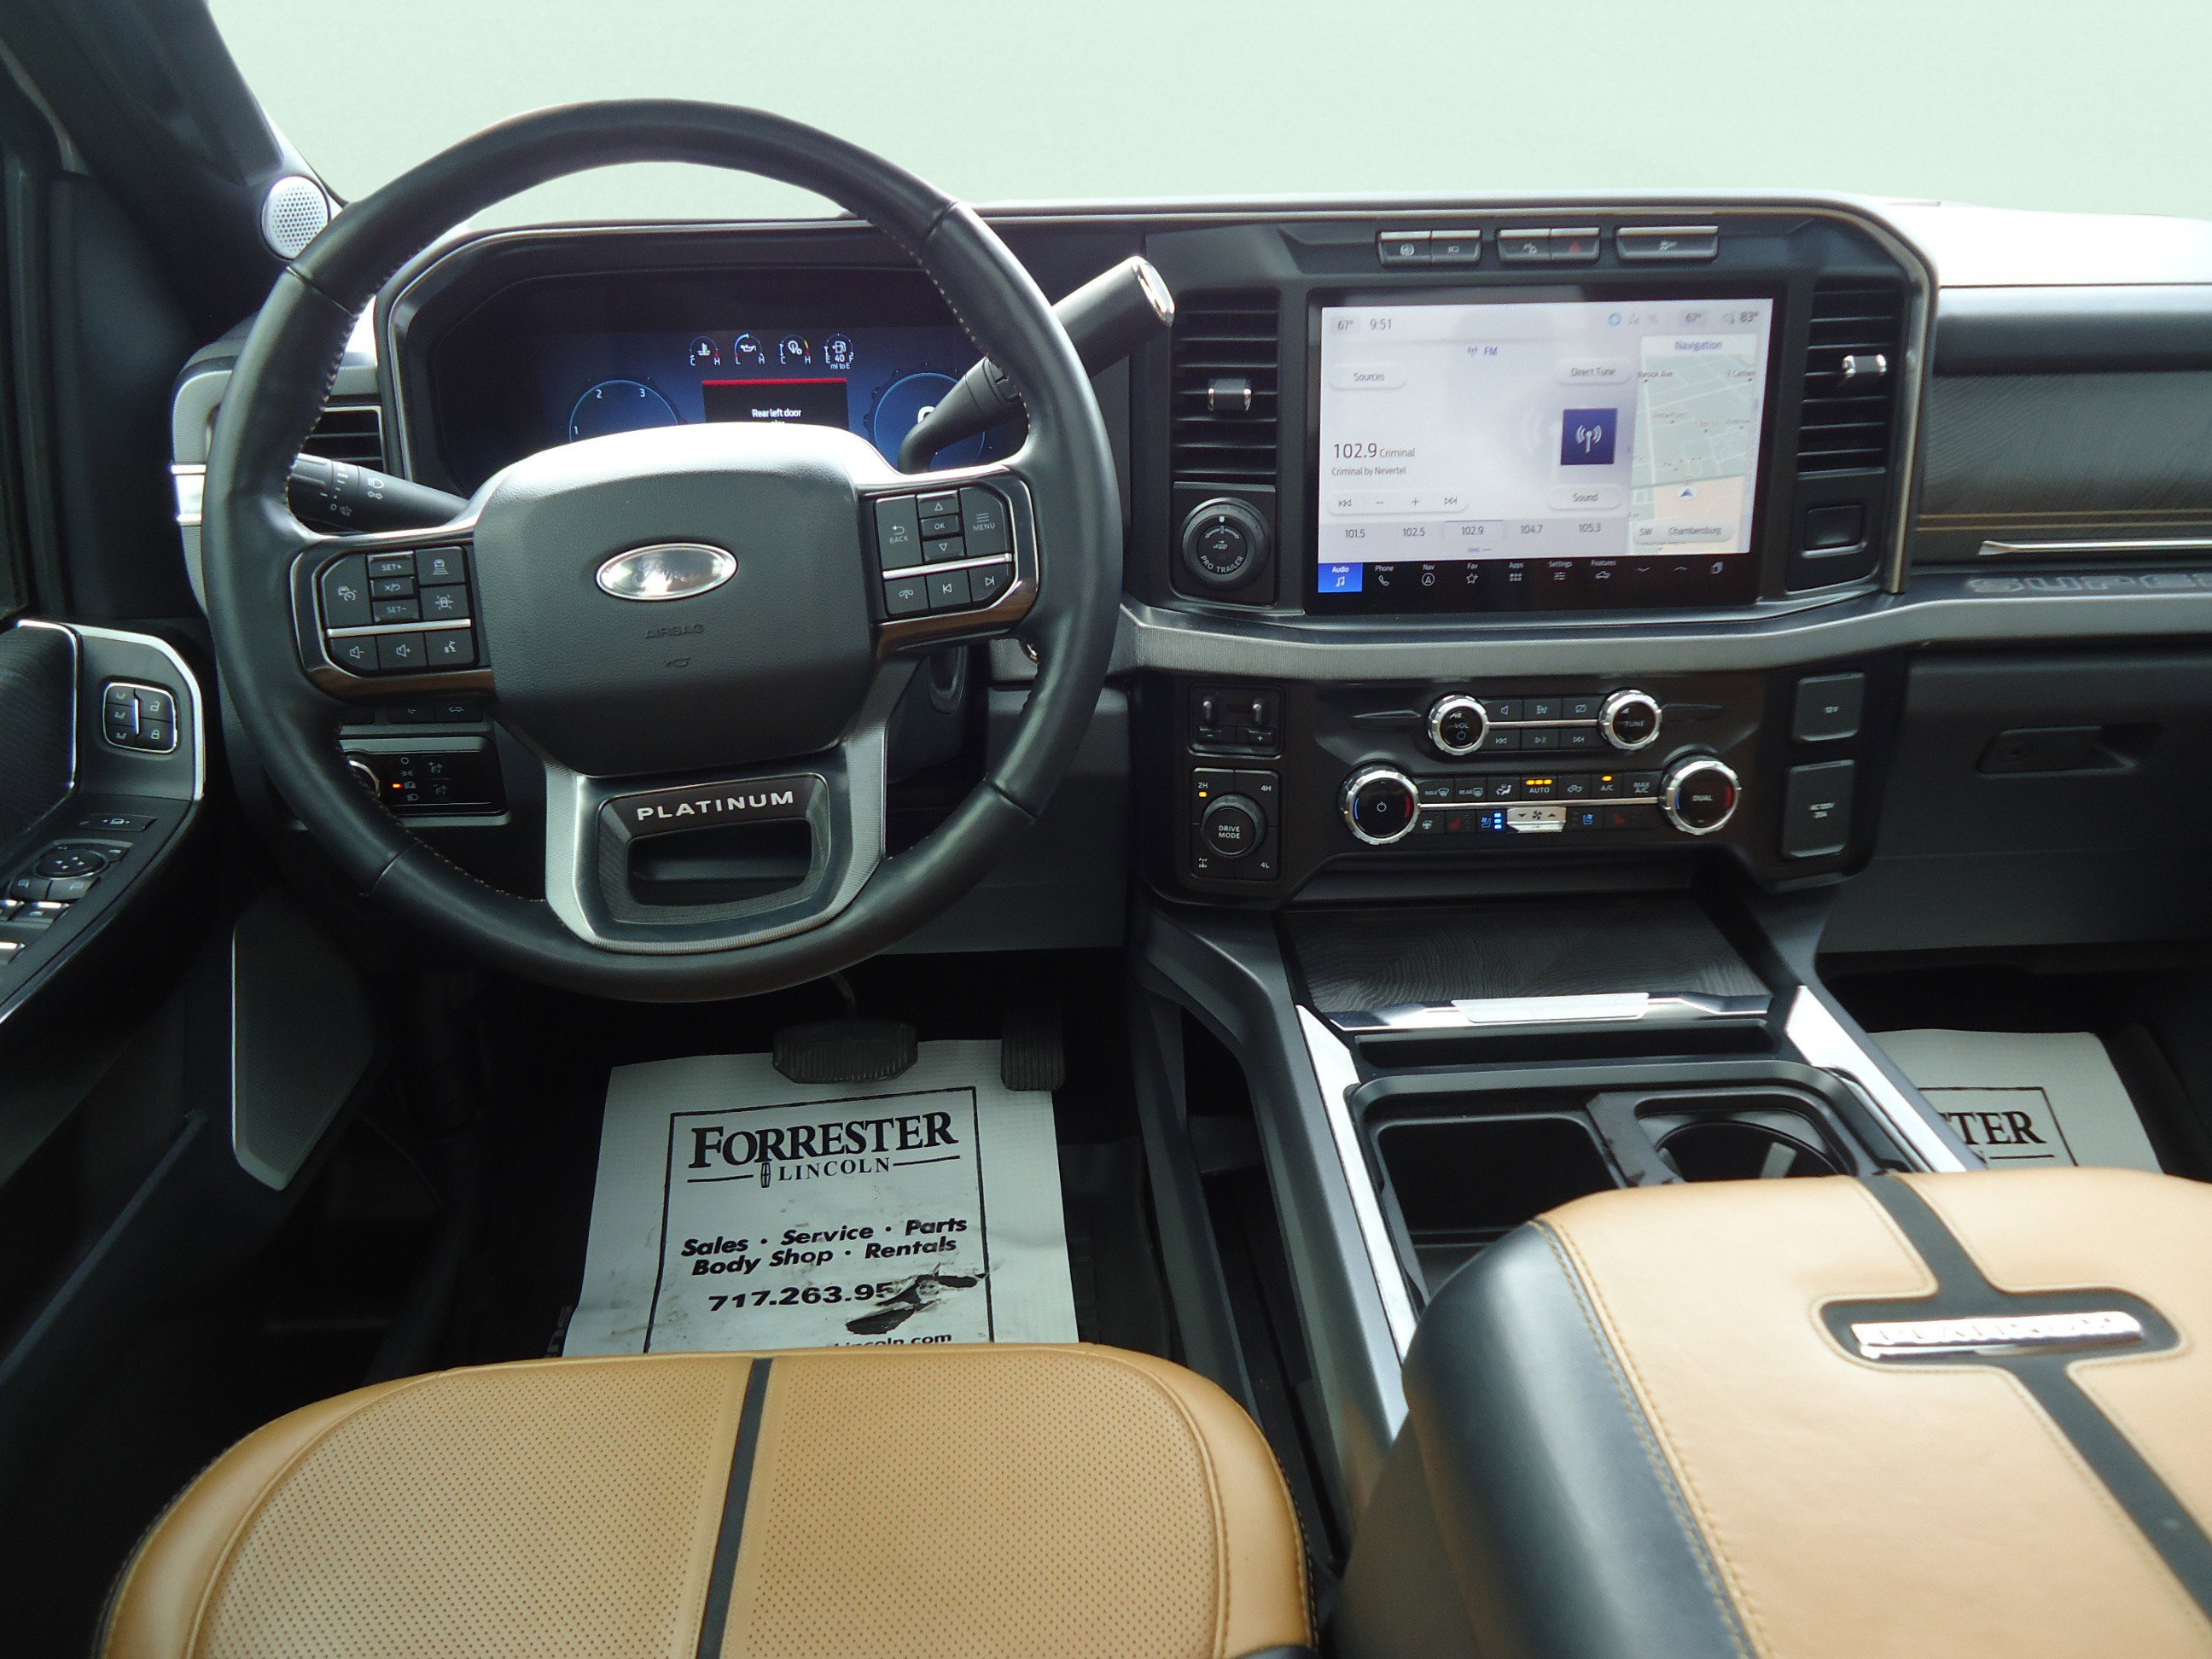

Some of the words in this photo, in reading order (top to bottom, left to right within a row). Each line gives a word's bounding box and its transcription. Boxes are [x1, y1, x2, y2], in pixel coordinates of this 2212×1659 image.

[1370, 318, 1393, 330] 9:51
[1484, 346, 1498, 356] FM
[1674, 341, 1722, 352] Navigation
[713, 357, 721, 366] H
[758, 355, 765, 364] H
[780, 356, 786, 364] C
[805, 355, 812, 364] H
[825, 354, 830, 364] E
[835, 354, 845, 363] 40
[1353, 372, 1385, 381] Sources
[1571, 367, 1594, 376] Direct
[1597, 367, 1616, 375] Tune
[596, 389, 602, 399] 2
[639, 388, 646, 398] 3
[751, 409, 769, 418] Rear
[769, 408, 783, 417] left
[783, 408, 801, 416] door
[573, 425, 579, 435] 1
[1334, 443, 1377, 459] 102.9
[1379, 448, 1415, 458] Criminal
[1331, 467, 1363, 476] Criminal
[1364, 467, 1373, 477] by
[1375, 467, 1406, 475] Nevertel
[1573, 493, 1598, 502] Sound
[973, 522, 995, 532] MENU
[1345, 528, 1365, 538] 101.5
[1403, 527, 1425, 537] 102.5
[1462, 526, 1484, 536] 102.9
[1521, 524, 1543, 534] 104.7
[1579, 523, 1601, 533] 105.3
[1639, 527, 1653, 536] SW
[1668, 527, 1722, 536] Chambersburg
[889, 535, 910, 544] BACK
[1200, 555, 1214, 570] PRO
[1216, 556, 1244, 573] TRAILER
[1509, 562, 1524, 570] Apps
[1548, 560, 1574, 569] Settings
[1591, 558, 1617, 568] Features
[637, 790, 794, 821] PLATINUM
[1218, 831, 1241, 840] MODE
[1940, 1111, 2046, 1144] TER
[688, 1111, 959, 1169] FORRESTER
[778, 1157, 890, 1181] LINCOLN
[680, 1236, 749, 1257] Sales
[780, 1224, 874, 1246] Service
[905, 1216, 968, 1237] Parts
[692, 1254, 762, 1276] Body
[769, 1248, 834, 1267] Shop
[864, 1236, 957, 1259] Rentals
[708, 1282, 905, 1312] 717.263.95
